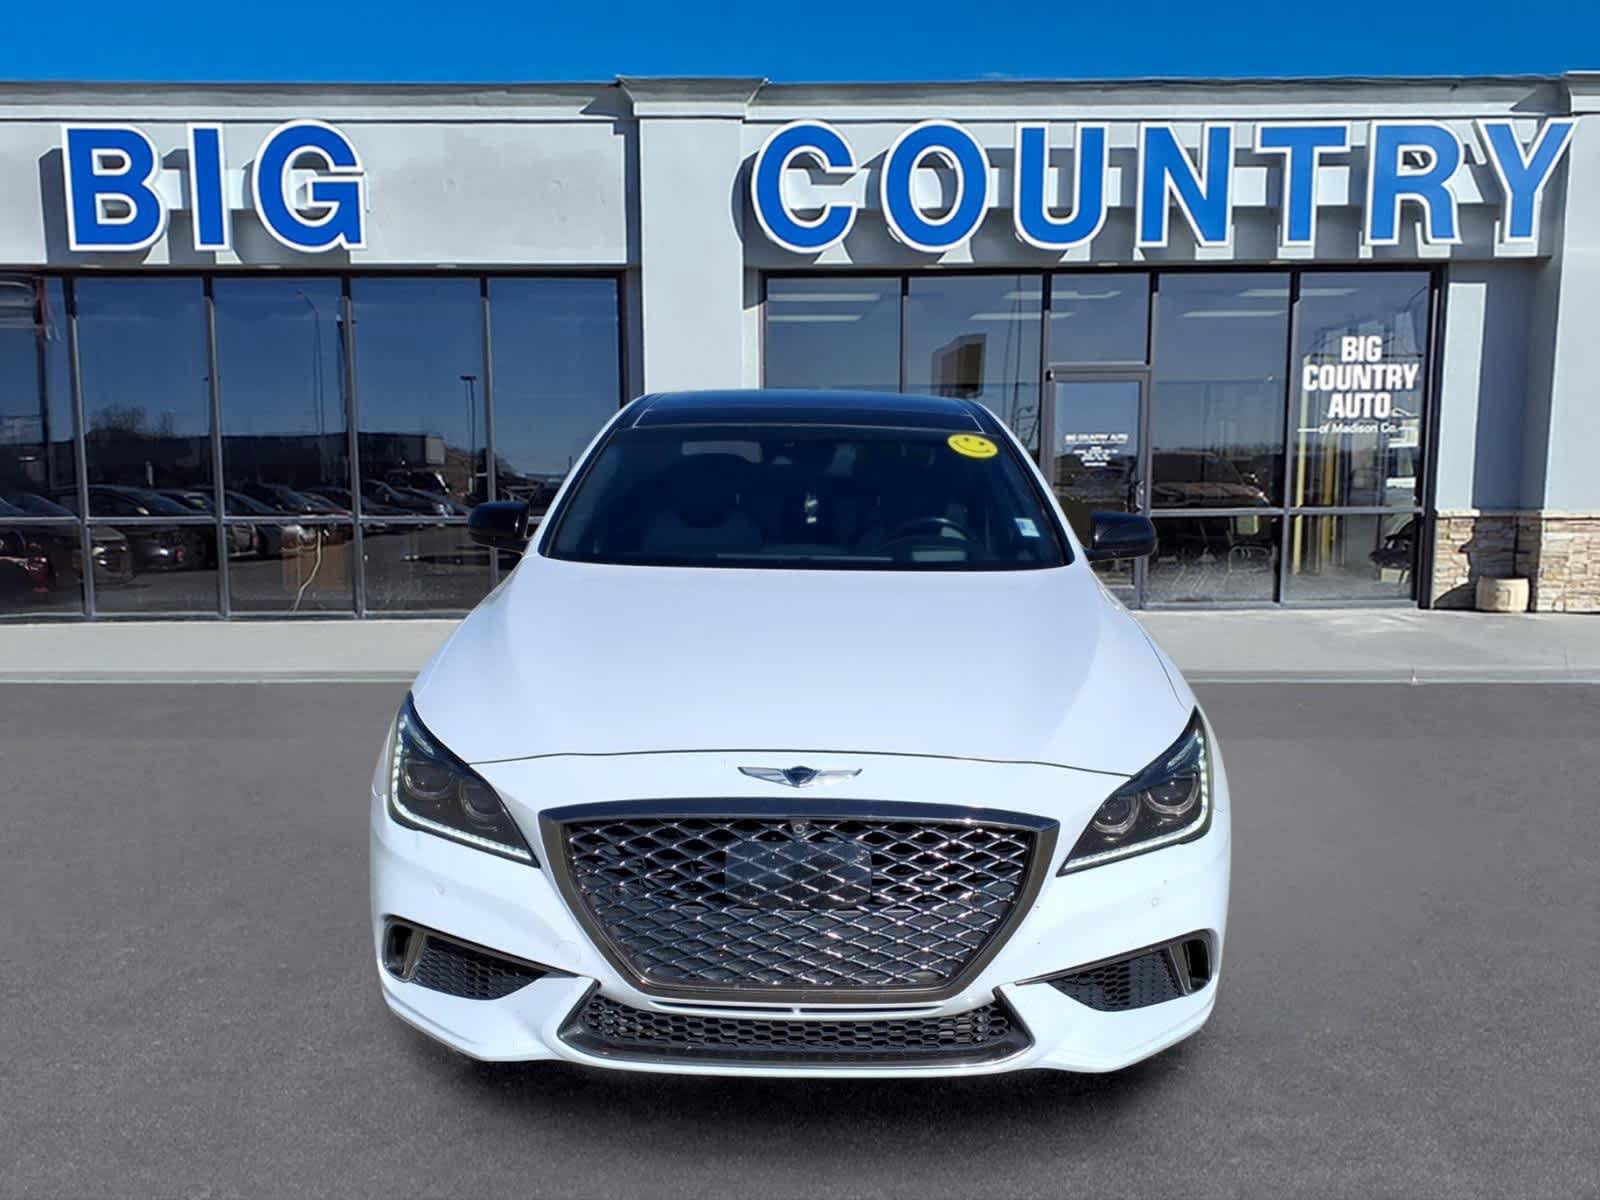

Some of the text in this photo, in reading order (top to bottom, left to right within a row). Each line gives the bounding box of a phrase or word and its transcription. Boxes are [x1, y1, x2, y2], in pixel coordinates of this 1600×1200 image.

[62, 118, 1576, 254] BIG COUNTRY
[1341, 335, 1382, 363] BIG
[1302, 363, 1420, 391] COUNTRY
[1327, 392, 1392, 419] AUTO
[1331, 423, 1379, 434] Madison
